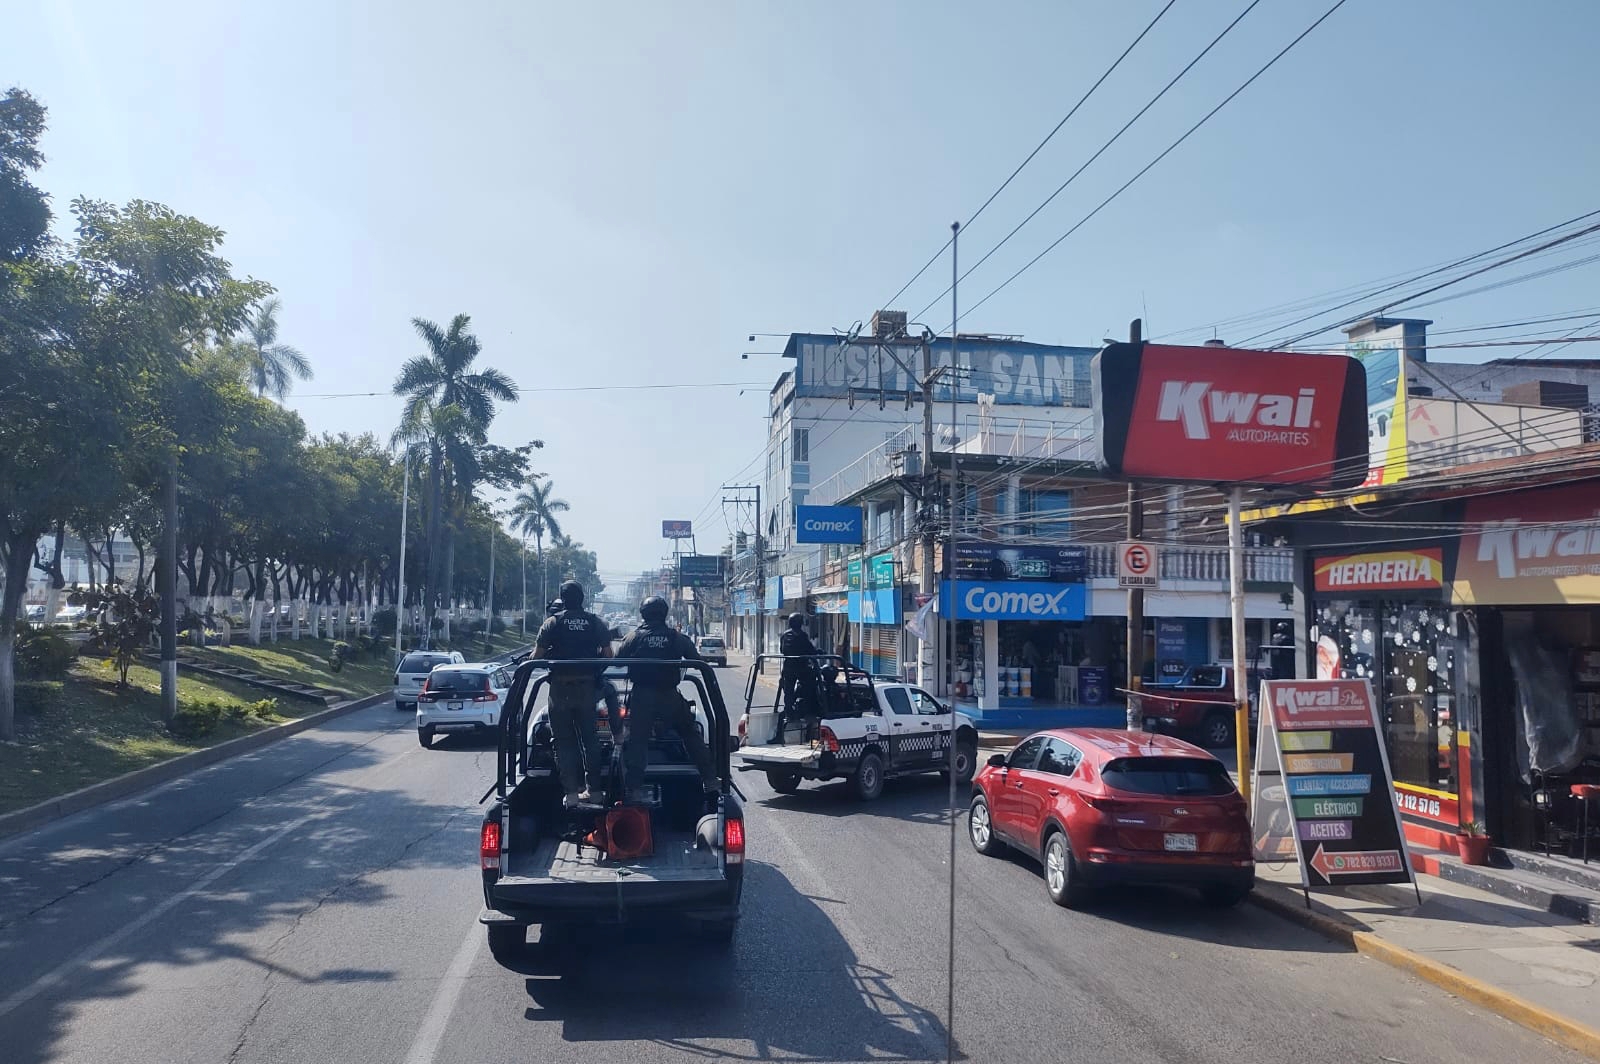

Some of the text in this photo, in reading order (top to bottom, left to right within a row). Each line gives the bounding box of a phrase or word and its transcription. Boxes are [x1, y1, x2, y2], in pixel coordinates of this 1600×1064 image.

[802, 343, 1075, 401] HOSPITAL SAN
[1156, 381, 1316, 439] Kwai
[1226, 429, 1310, 446] AUTOPARTES
[804, 519, 855, 532] Comex
[1328, 559, 1433, 586] HERRERIA
[965, 587, 1071, 615] Comex
[1276, 686, 1339, 714] Kwai
[1314, 800, 1357, 815] ELÉCTRICO
[1405, 794, 1417, 810] 112
[1419, 798, 1428, 813] 57
[1429, 801, 1440, 816] 05
[1310, 823, 1346, 837] ACEITES
[1345, 857, 1361, 867] 782
